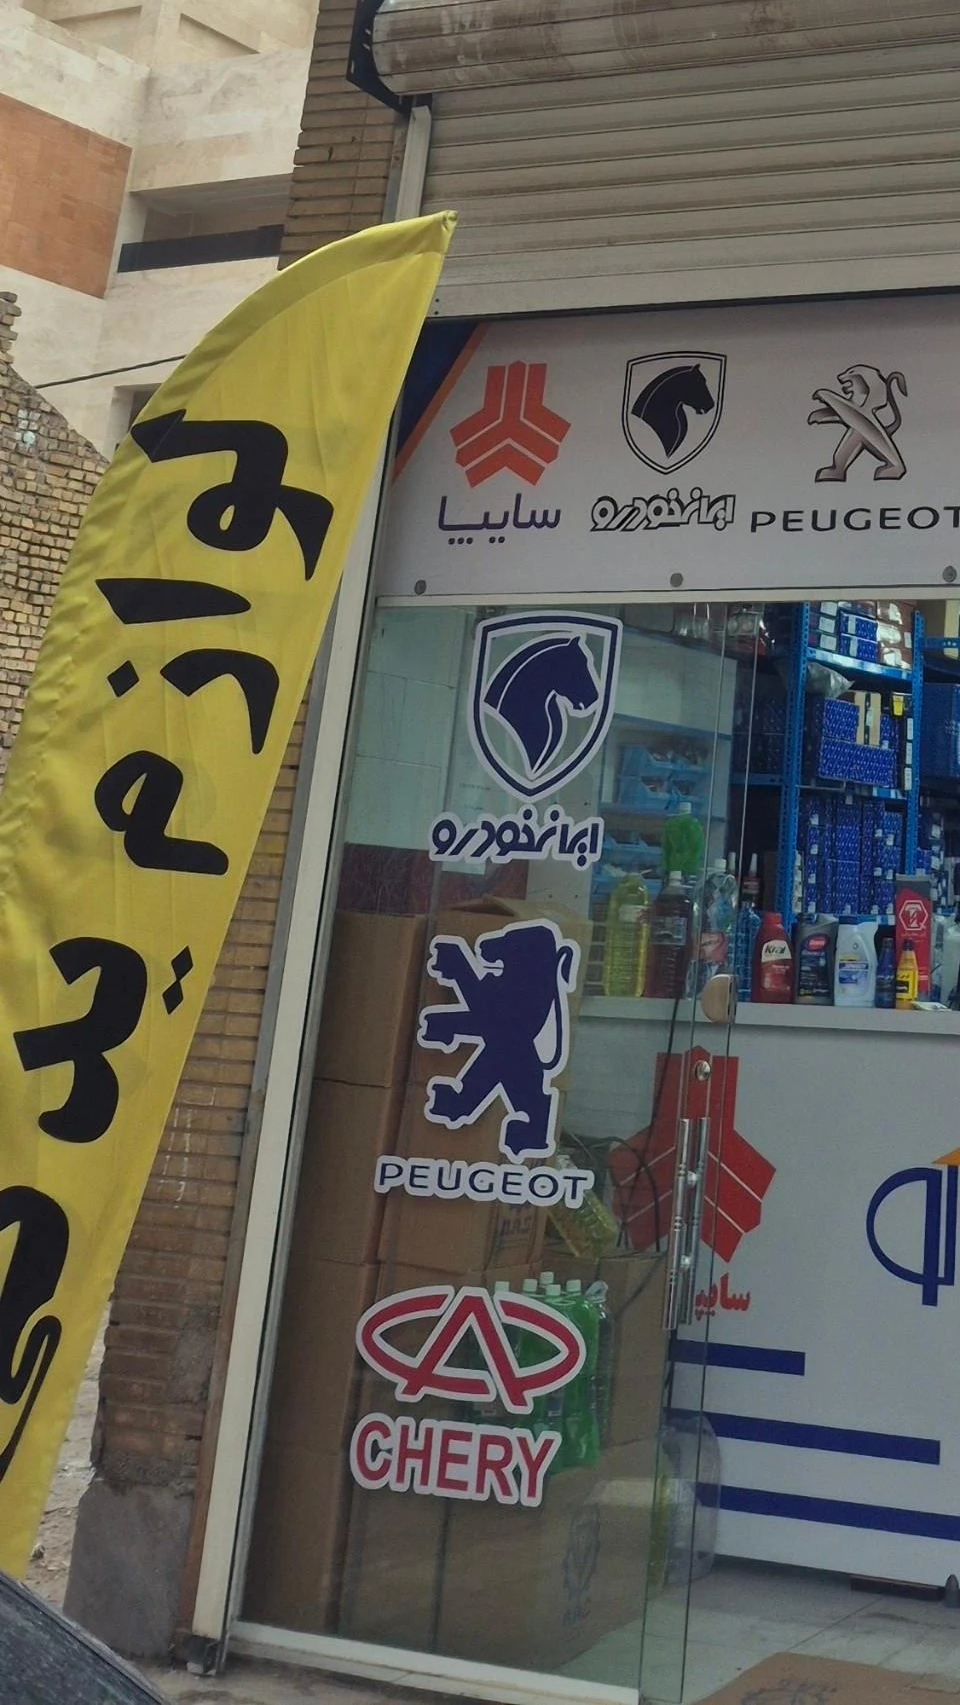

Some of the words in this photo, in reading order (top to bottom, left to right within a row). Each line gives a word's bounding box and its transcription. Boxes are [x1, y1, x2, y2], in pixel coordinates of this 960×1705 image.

[437, 492, 562, 545] سایپا
[94, 407, 334, 877] لوازم
[378, 1162, 589, 1201] PEUGEOT
[356, 1420, 554, 1499] CHERY
